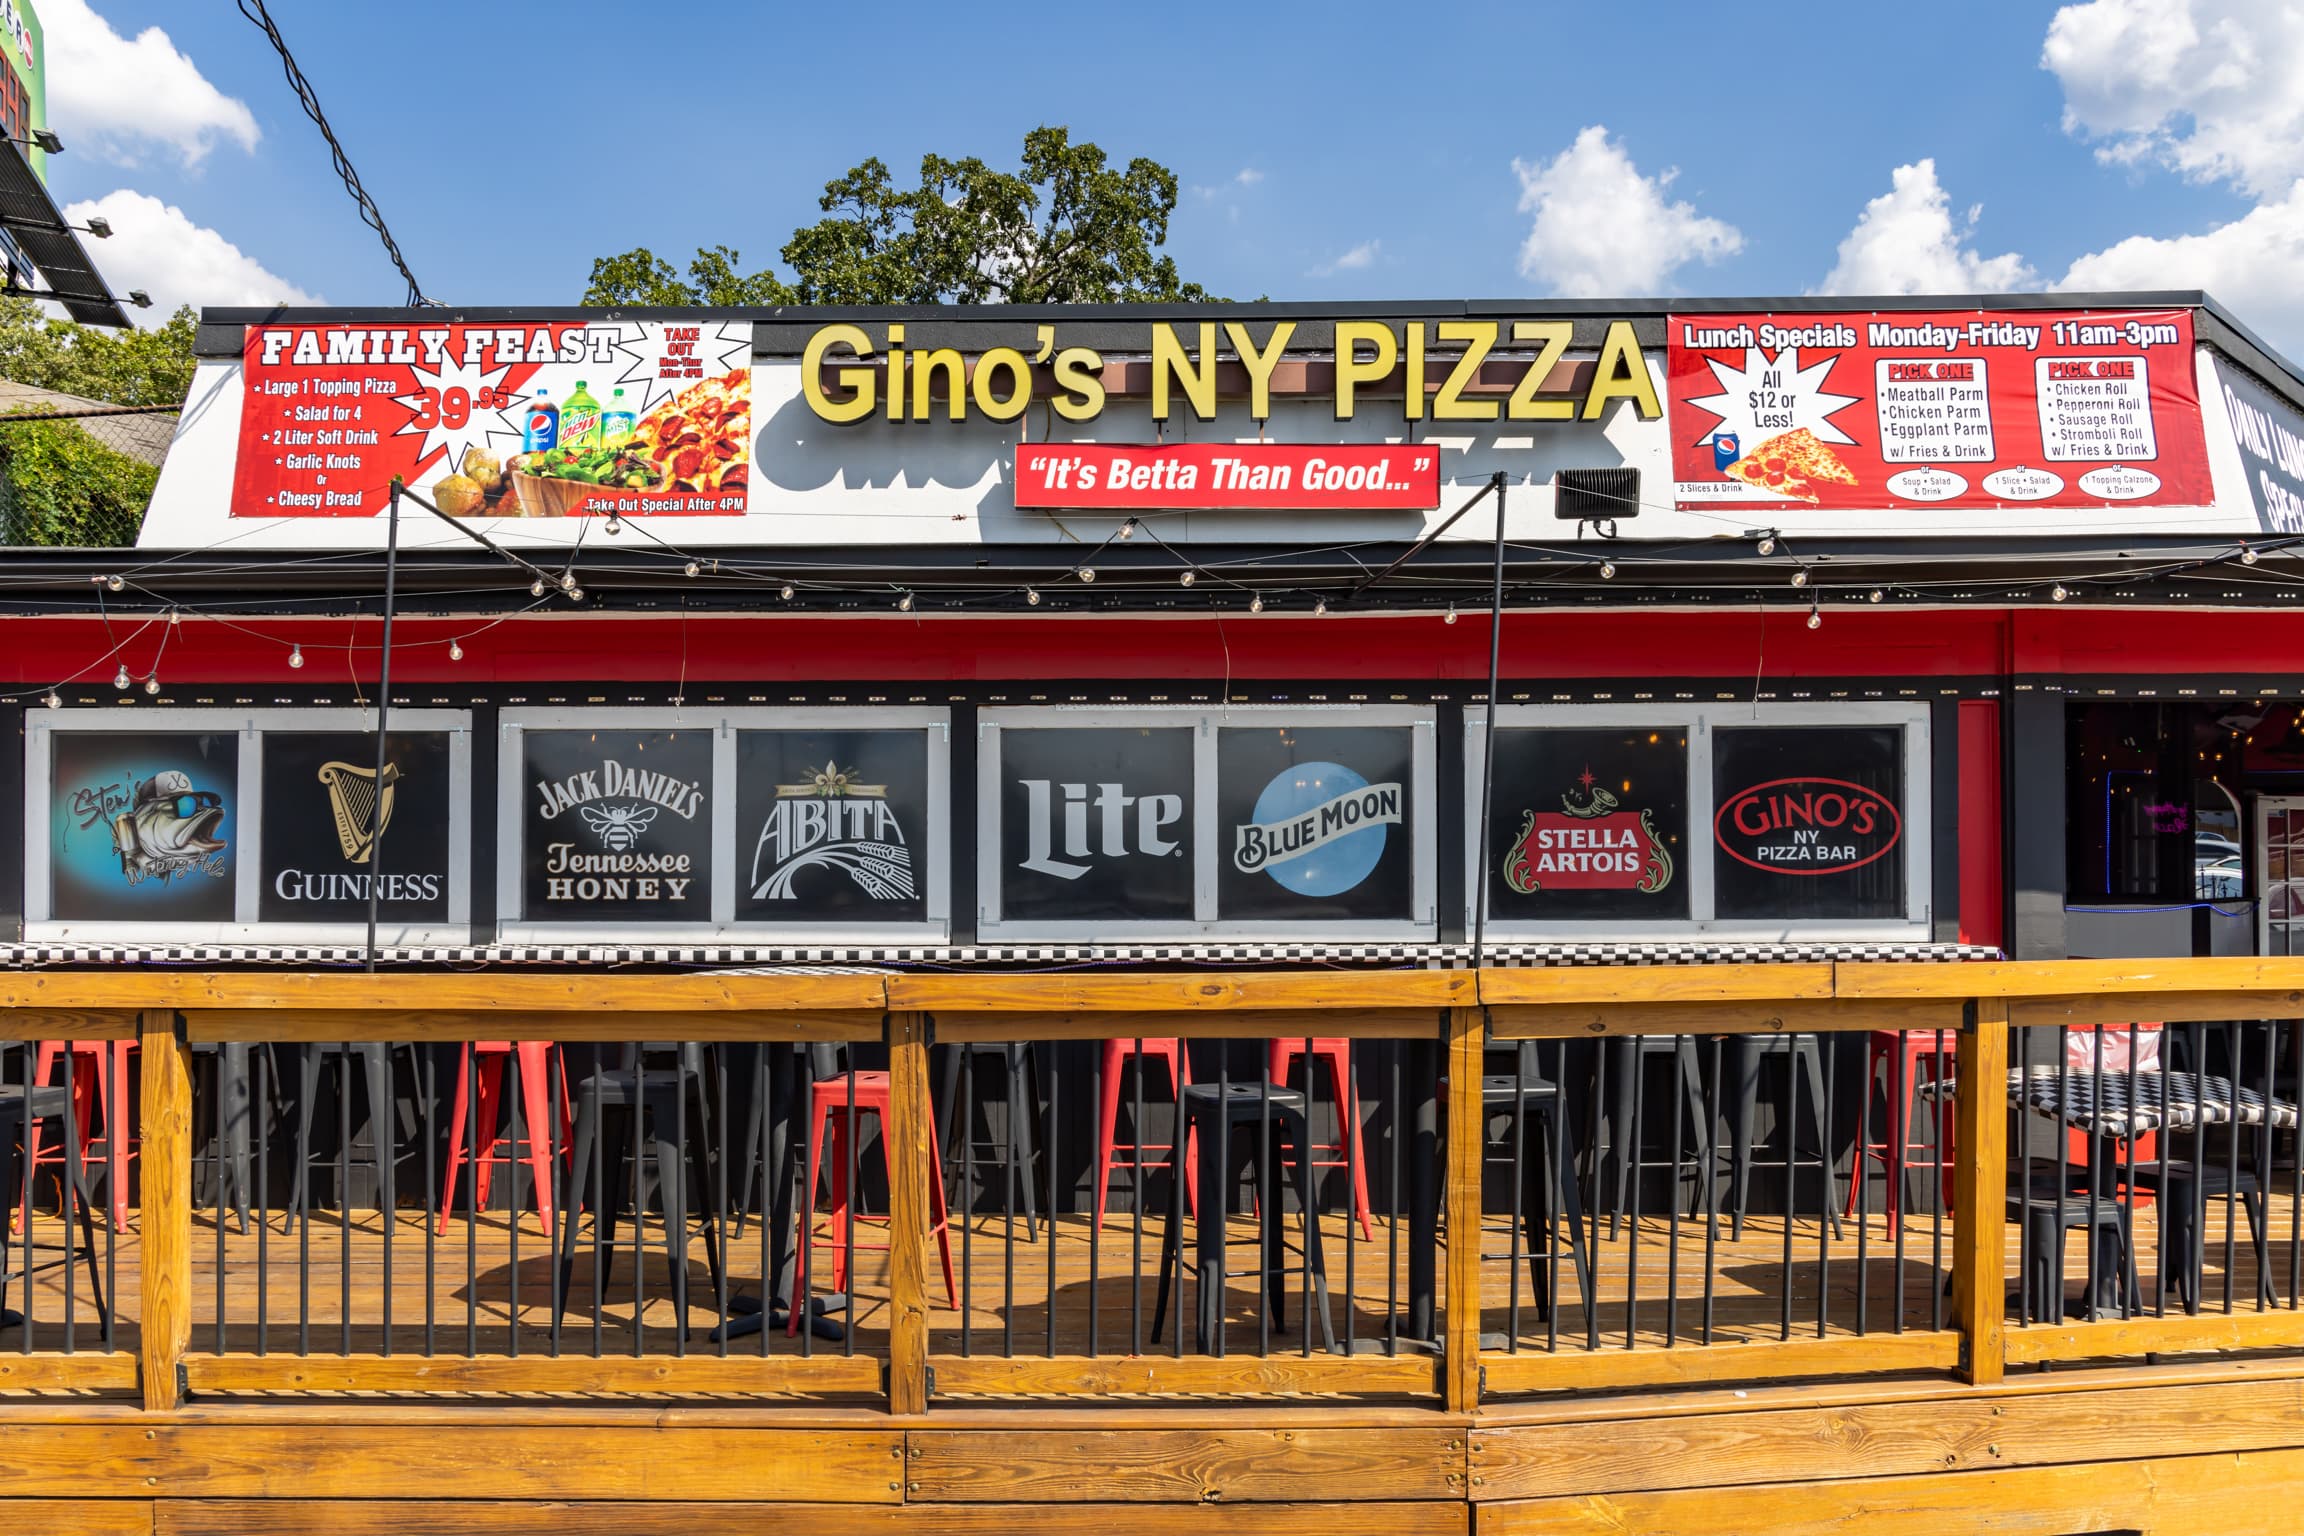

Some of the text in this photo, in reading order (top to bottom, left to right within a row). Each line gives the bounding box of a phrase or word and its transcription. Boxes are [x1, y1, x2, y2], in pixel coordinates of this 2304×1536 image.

[664, 327, 700, 341] TAKE
[1683, 320, 2178, 352] Lunch Specials Monday-Friday 11am-3pm
[261, 328, 621, 365] FAMILY FEAST
[667, 342, 694, 356] OUT
[659, 357, 703, 367] Mon-Thur
[2048, 361, 2134, 377] PICK ONE
[659, 368, 703, 378] After 4PM
[801, 320, 1663, 424] Gino's NY PIZZA
[1762, 370, 1781, 388] All
[1888, 363, 1974, 379] PICK ONE
[264, 378, 397, 397] Large 1 Topping Pizza
[1888, 387, 1983, 401] Meatball Parm
[2055, 383, 2127, 395] Chicken Roll
[411, 386, 509, 430] 39.95
[1749, 391, 1796, 410] $12 or
[2056, 398, 2140, 412] Pepperoni Roll
[295, 405, 362, 421] Salad for 4
[1754, 411, 1794, 428] Less!
[1889, 405, 1981, 419] Chicken Parm
[2058, 413, 2133, 427] Sausage Roll
[273, 429, 378, 445] 2 Liter Soft Drink
[1891, 422, 1988, 439] Eggplant Parm
[2060, 428, 2142, 440] Stromboli Roll
[1890, 444, 1987, 457] w/ Fries & Drink
[2052, 443, 2149, 456] w/ Fries & Drink
[286, 454, 361, 469] Garlic Knots
[316, 475, 327, 485] Or
[1107, 457, 1197, 491] Betta
[1210, 458, 1292, 491] Than
[1902, 477, 1951, 487] Soup Salad
[2002, 477, 2020, 485] Slice
[2029, 477, 2050, 485] Salad
[2091, 476, 2122, 486] Topping
[2123, 476, 2153, 484] Calzone
[1680, 483, 1743, 492] 2 Slices & Drink
[1922, 487, 1942, 495] Drink
[278, 491, 362, 509] Cheesy Bread
[588, 497, 744, 514] Take Out Special After 4PM
[2260, 470, 2304, 534] SPECI
[537, 759, 704, 820] JACK DANIEL'S
[1734, 793, 1880, 836] GINO'S
[1018, 779, 1182, 880] Lite
[1238, 789, 1397, 868] BLUE MOON
[341, 829, 354, 850] 1759
[751, 799, 906, 889] ABITA
[1537, 829, 1639, 850] STELLA
[1794, 830, 1820, 844] NY
[547, 842, 690, 874] Tennessee
[1757, 846, 1857, 860] PIZZA BAR
[1537, 852, 1640, 872] ARTOIS
[275, 868, 439, 901] GUINNESS
[547, 877, 691, 900] HONEY
